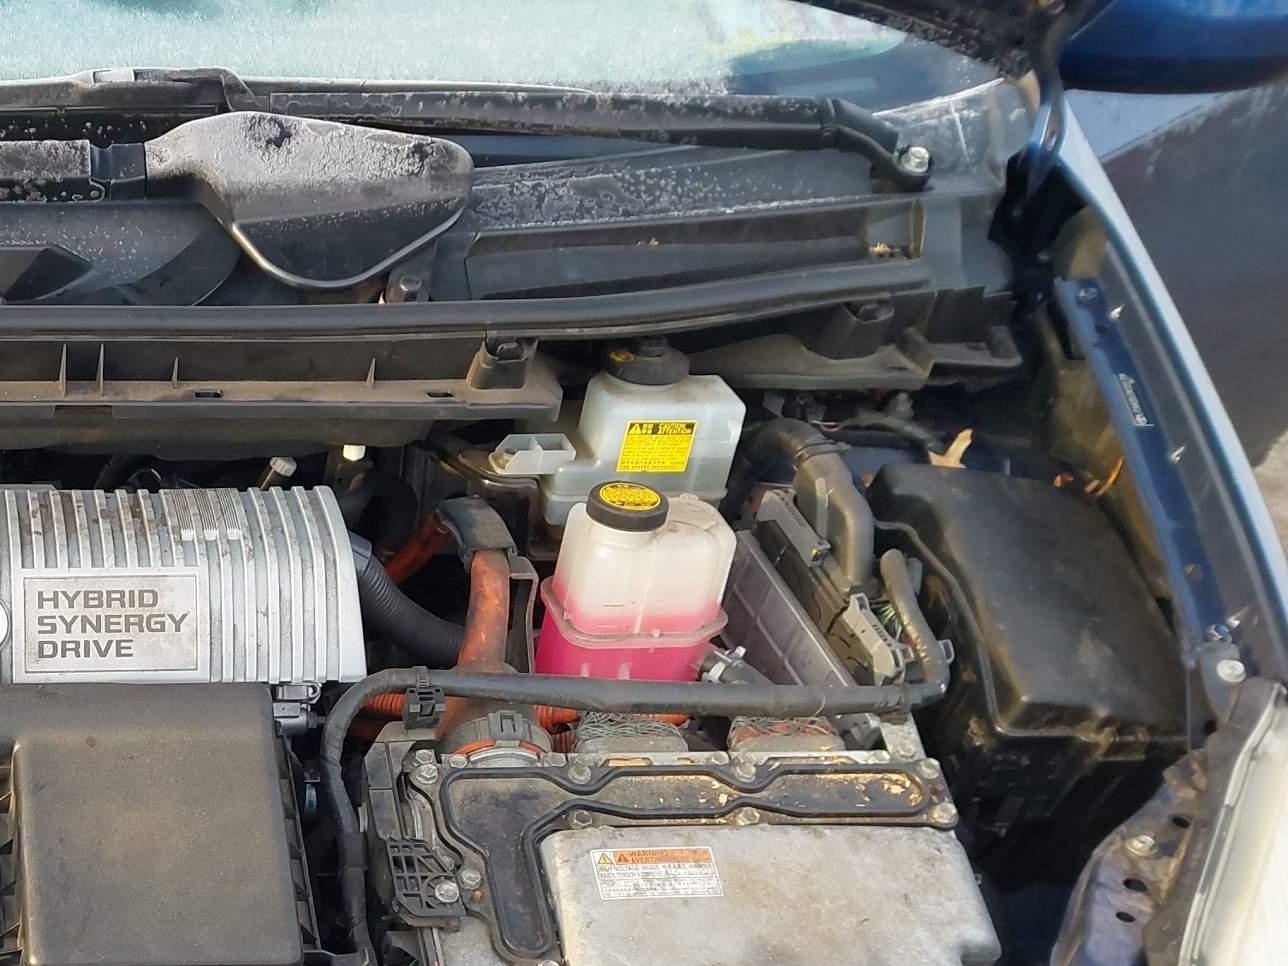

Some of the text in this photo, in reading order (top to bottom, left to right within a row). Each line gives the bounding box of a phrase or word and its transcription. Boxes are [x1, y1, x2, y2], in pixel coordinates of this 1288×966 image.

[37, 589, 159, 609] HYBRID
[37, 614, 189, 634] SYNERGY
[37, 639, 135, 659] DRIVE
